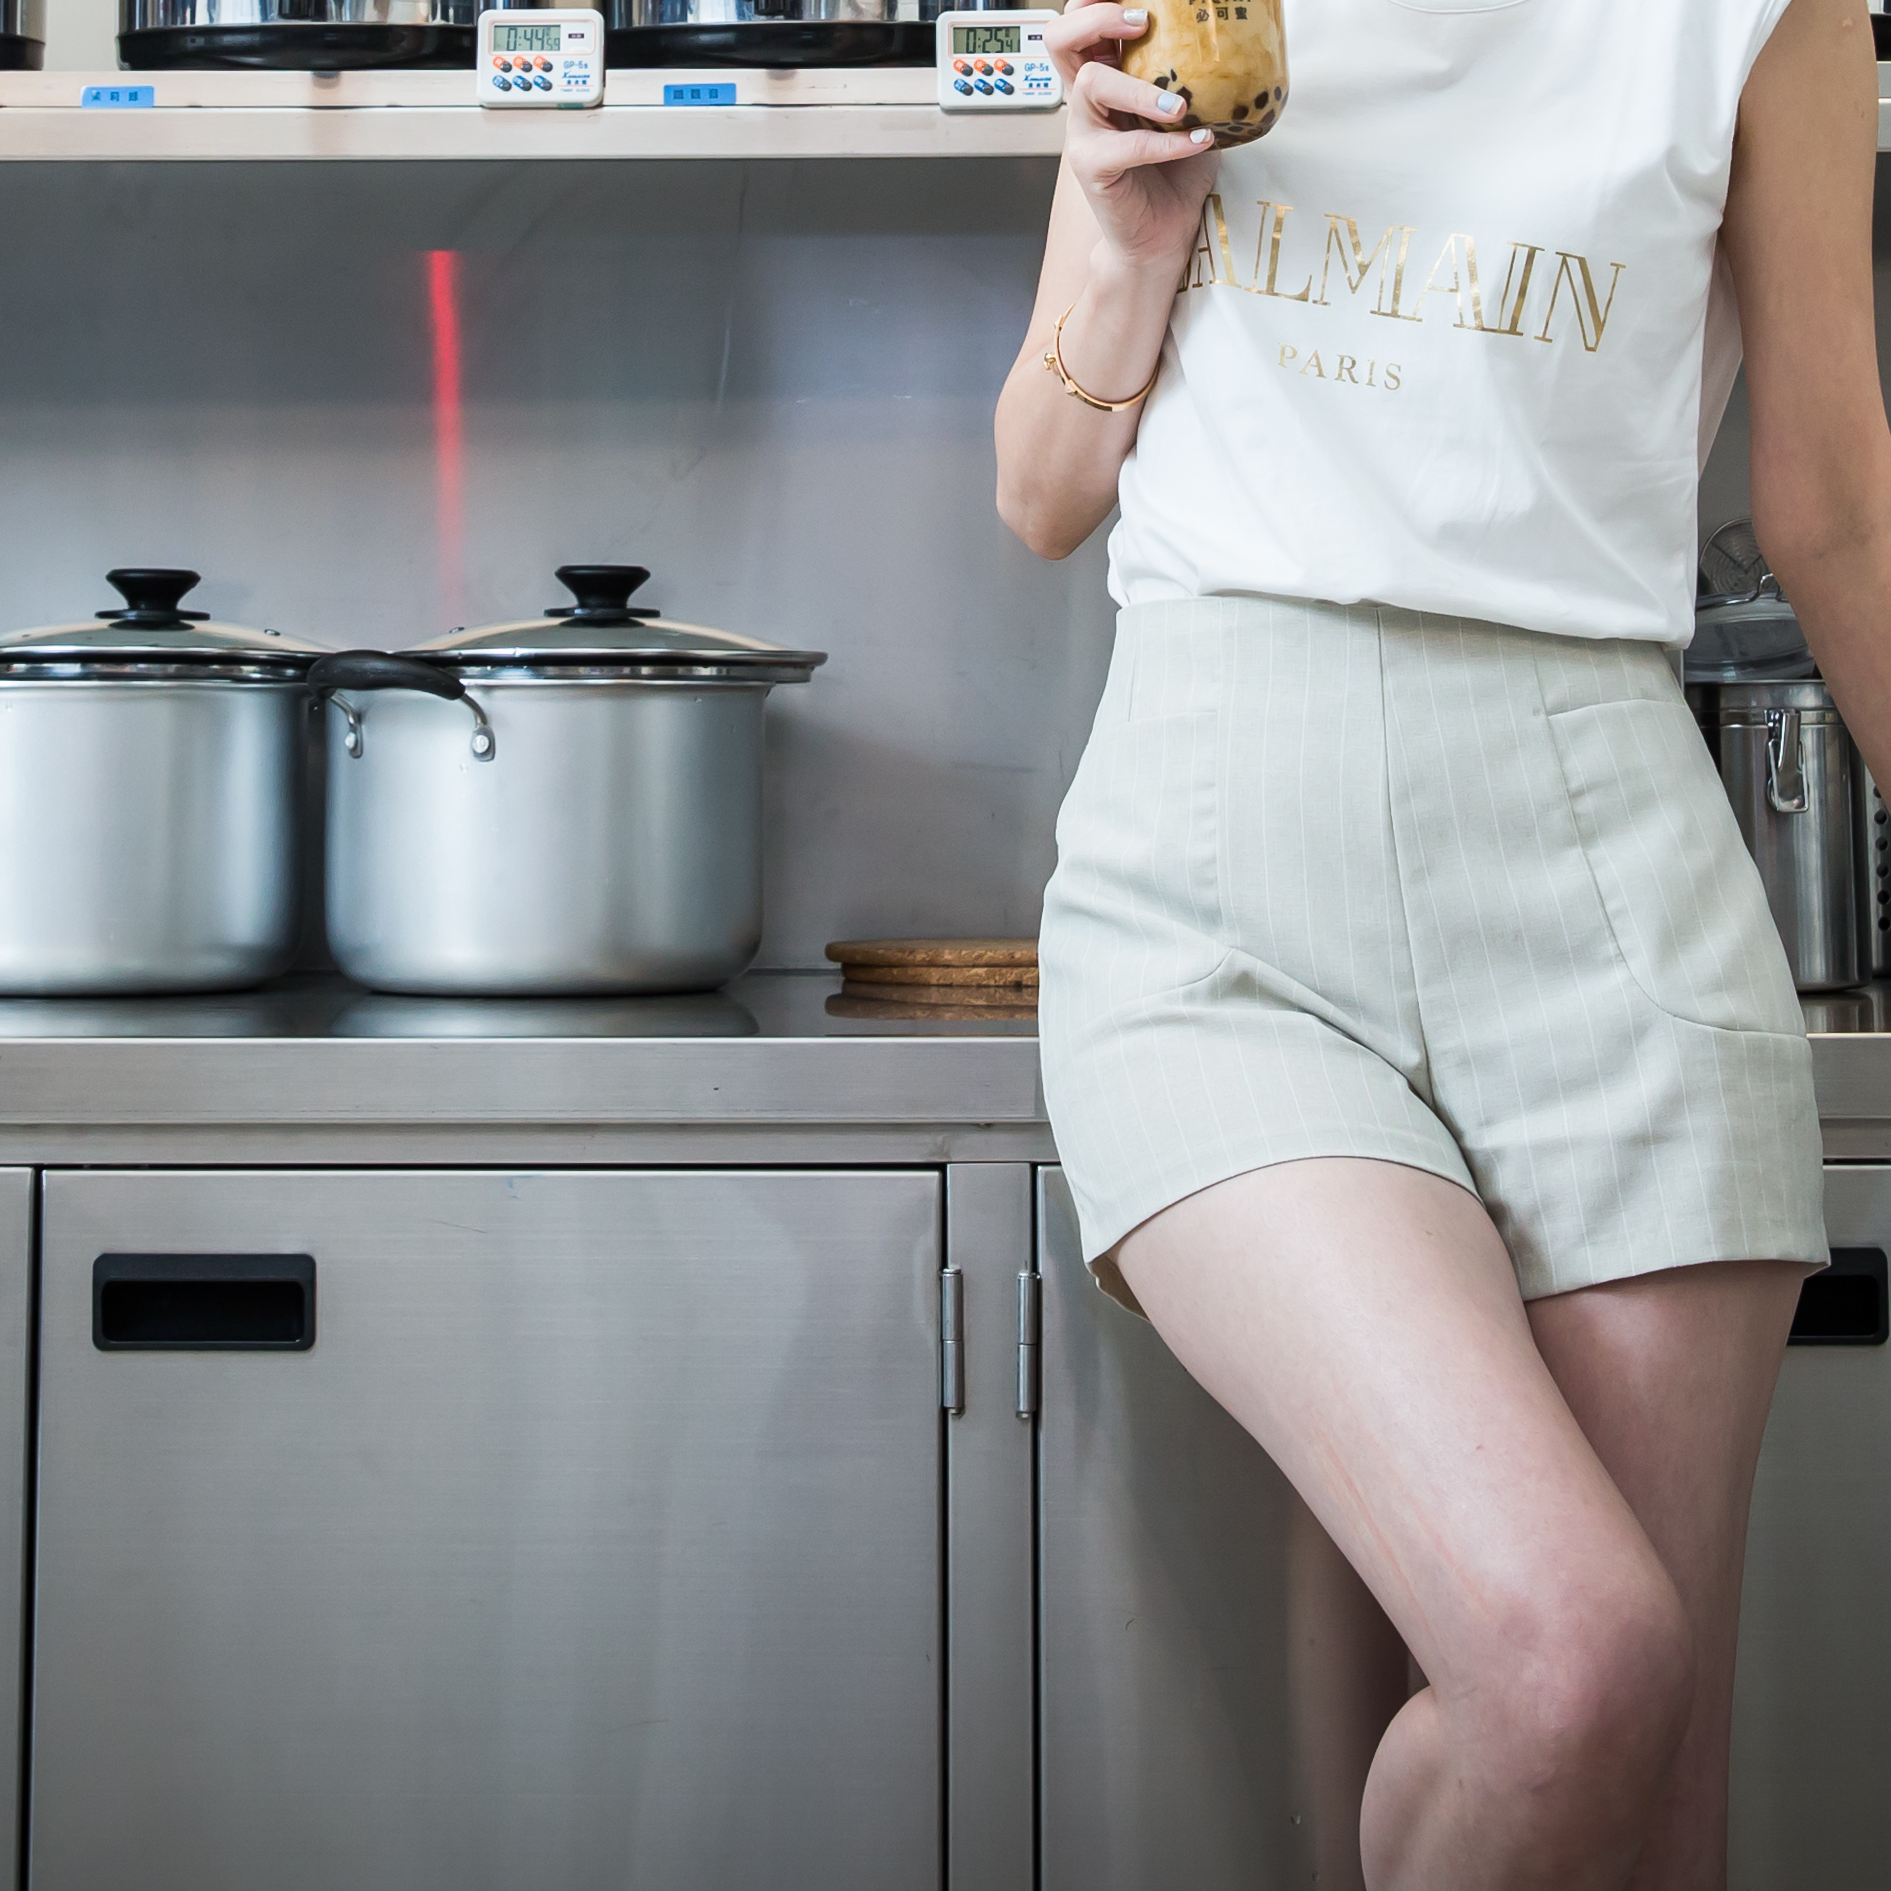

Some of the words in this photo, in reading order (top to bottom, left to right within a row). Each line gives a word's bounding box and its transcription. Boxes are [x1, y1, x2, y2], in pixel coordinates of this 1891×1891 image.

[1195, 5, 1248, 23] 必可蜜
[1176, 193, 1627, 353] ALMAIN
[1278, 342, 1402, 392] PARIS
